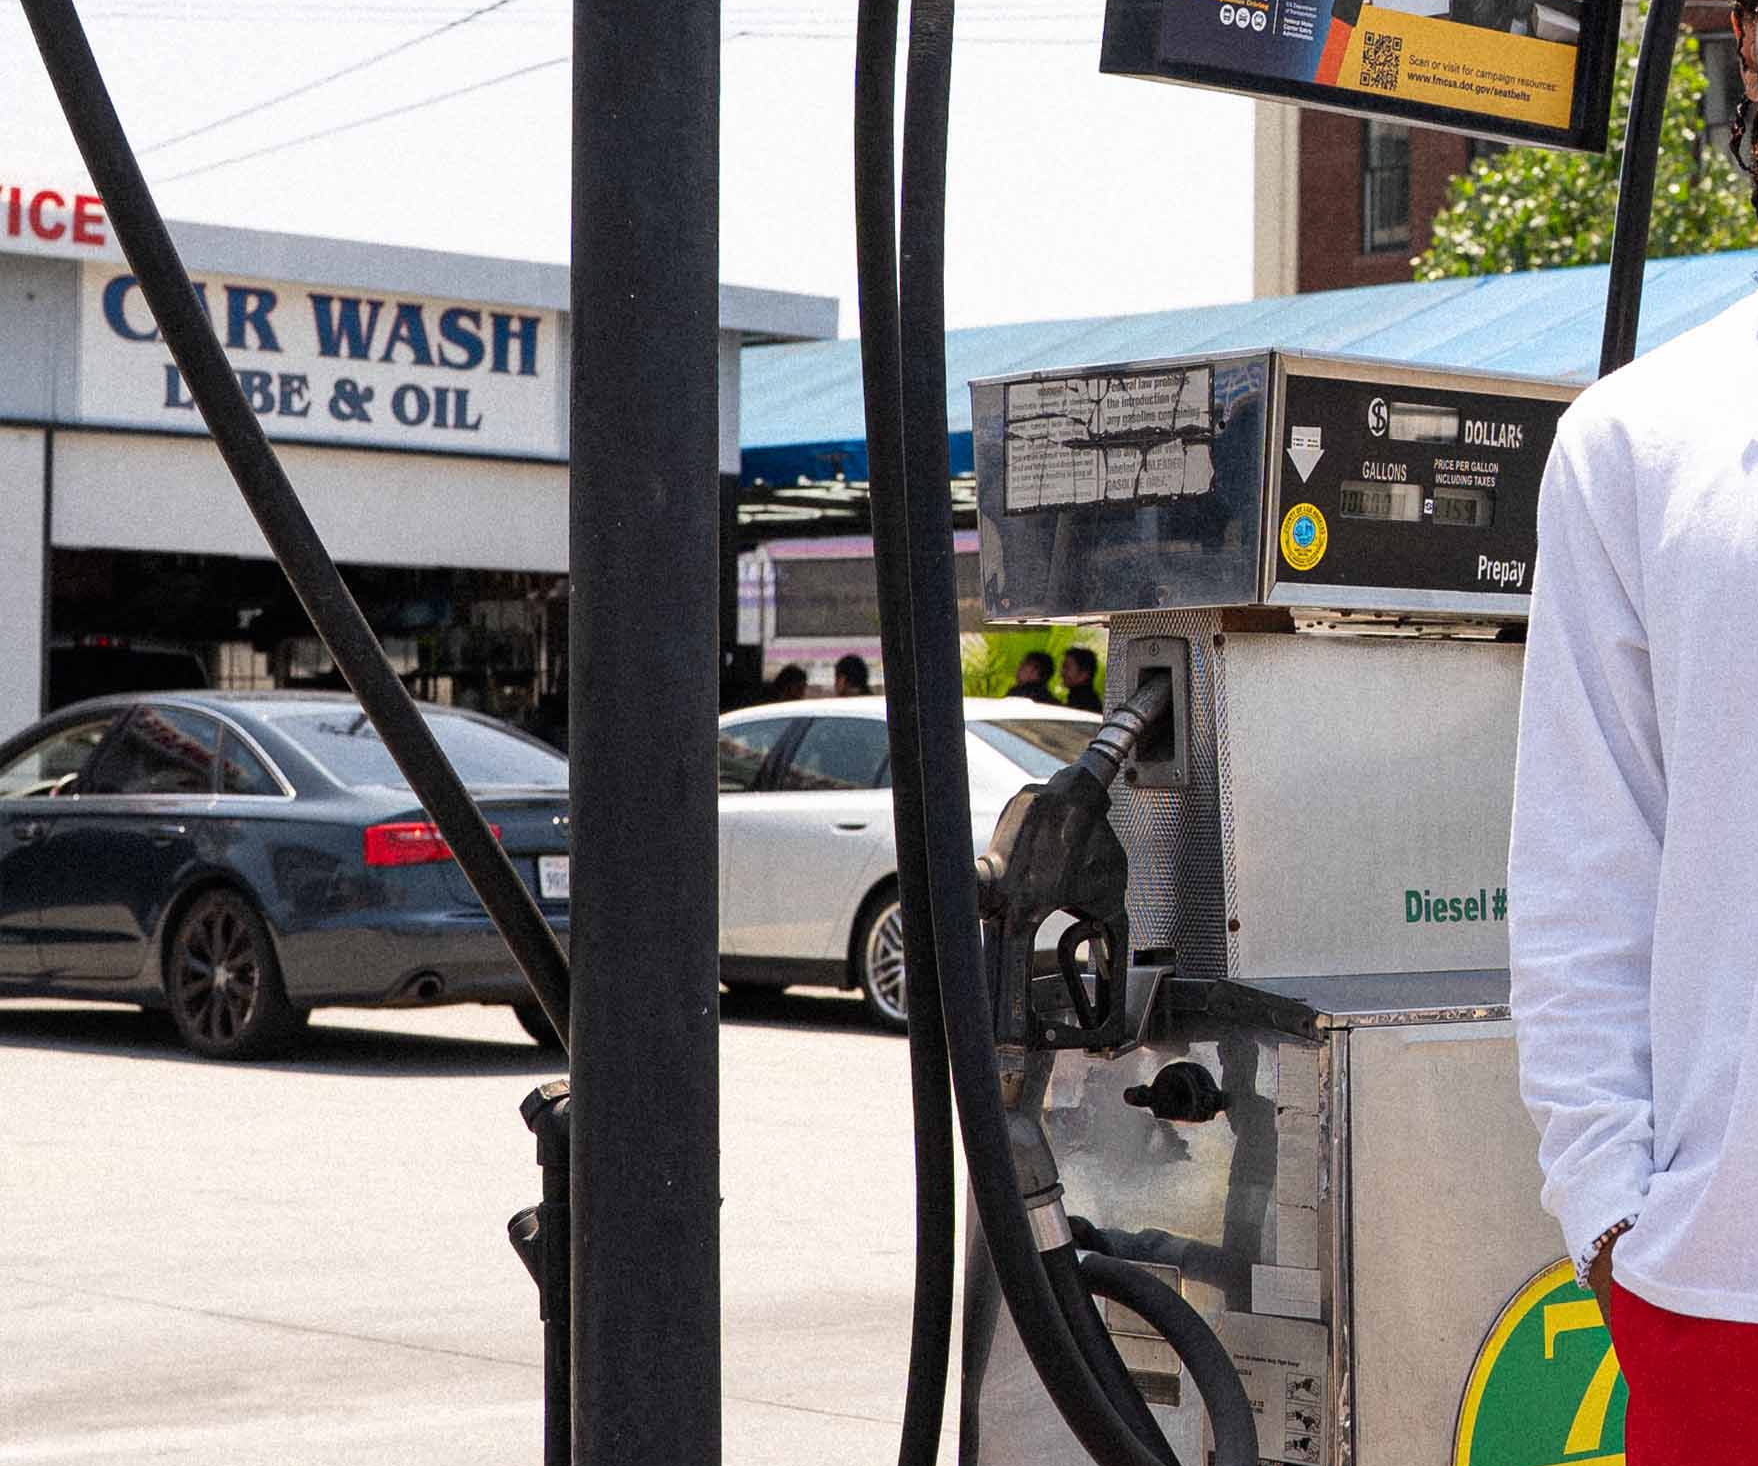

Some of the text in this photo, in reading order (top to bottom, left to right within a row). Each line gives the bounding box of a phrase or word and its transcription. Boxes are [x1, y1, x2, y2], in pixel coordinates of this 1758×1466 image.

[1408, 54, 1430, 68] Scan
[1431, 61, 1441, 70] or
[1462, 64, 1473, 76] for
[1475, 68, 1515, 86] campaign
[0, 184, 105, 246] ICE
[102, 273, 541, 377] CR WASH
[164, 364, 482, 431] LBE & OIL
[1464, 420, 1524, 448] DOLLARS
[1362, 461, 1407, 481] GALLONS
[1433, 458, 1499, 473] PRICE PER GALLON
[1435, 473, 1496, 487] INCLUDING TAXES
[1477, 555, 1526, 587] Prepay
[1405, 888, 1487, 923] Diesel
[1543, 1297, 1621, 1456] 7
